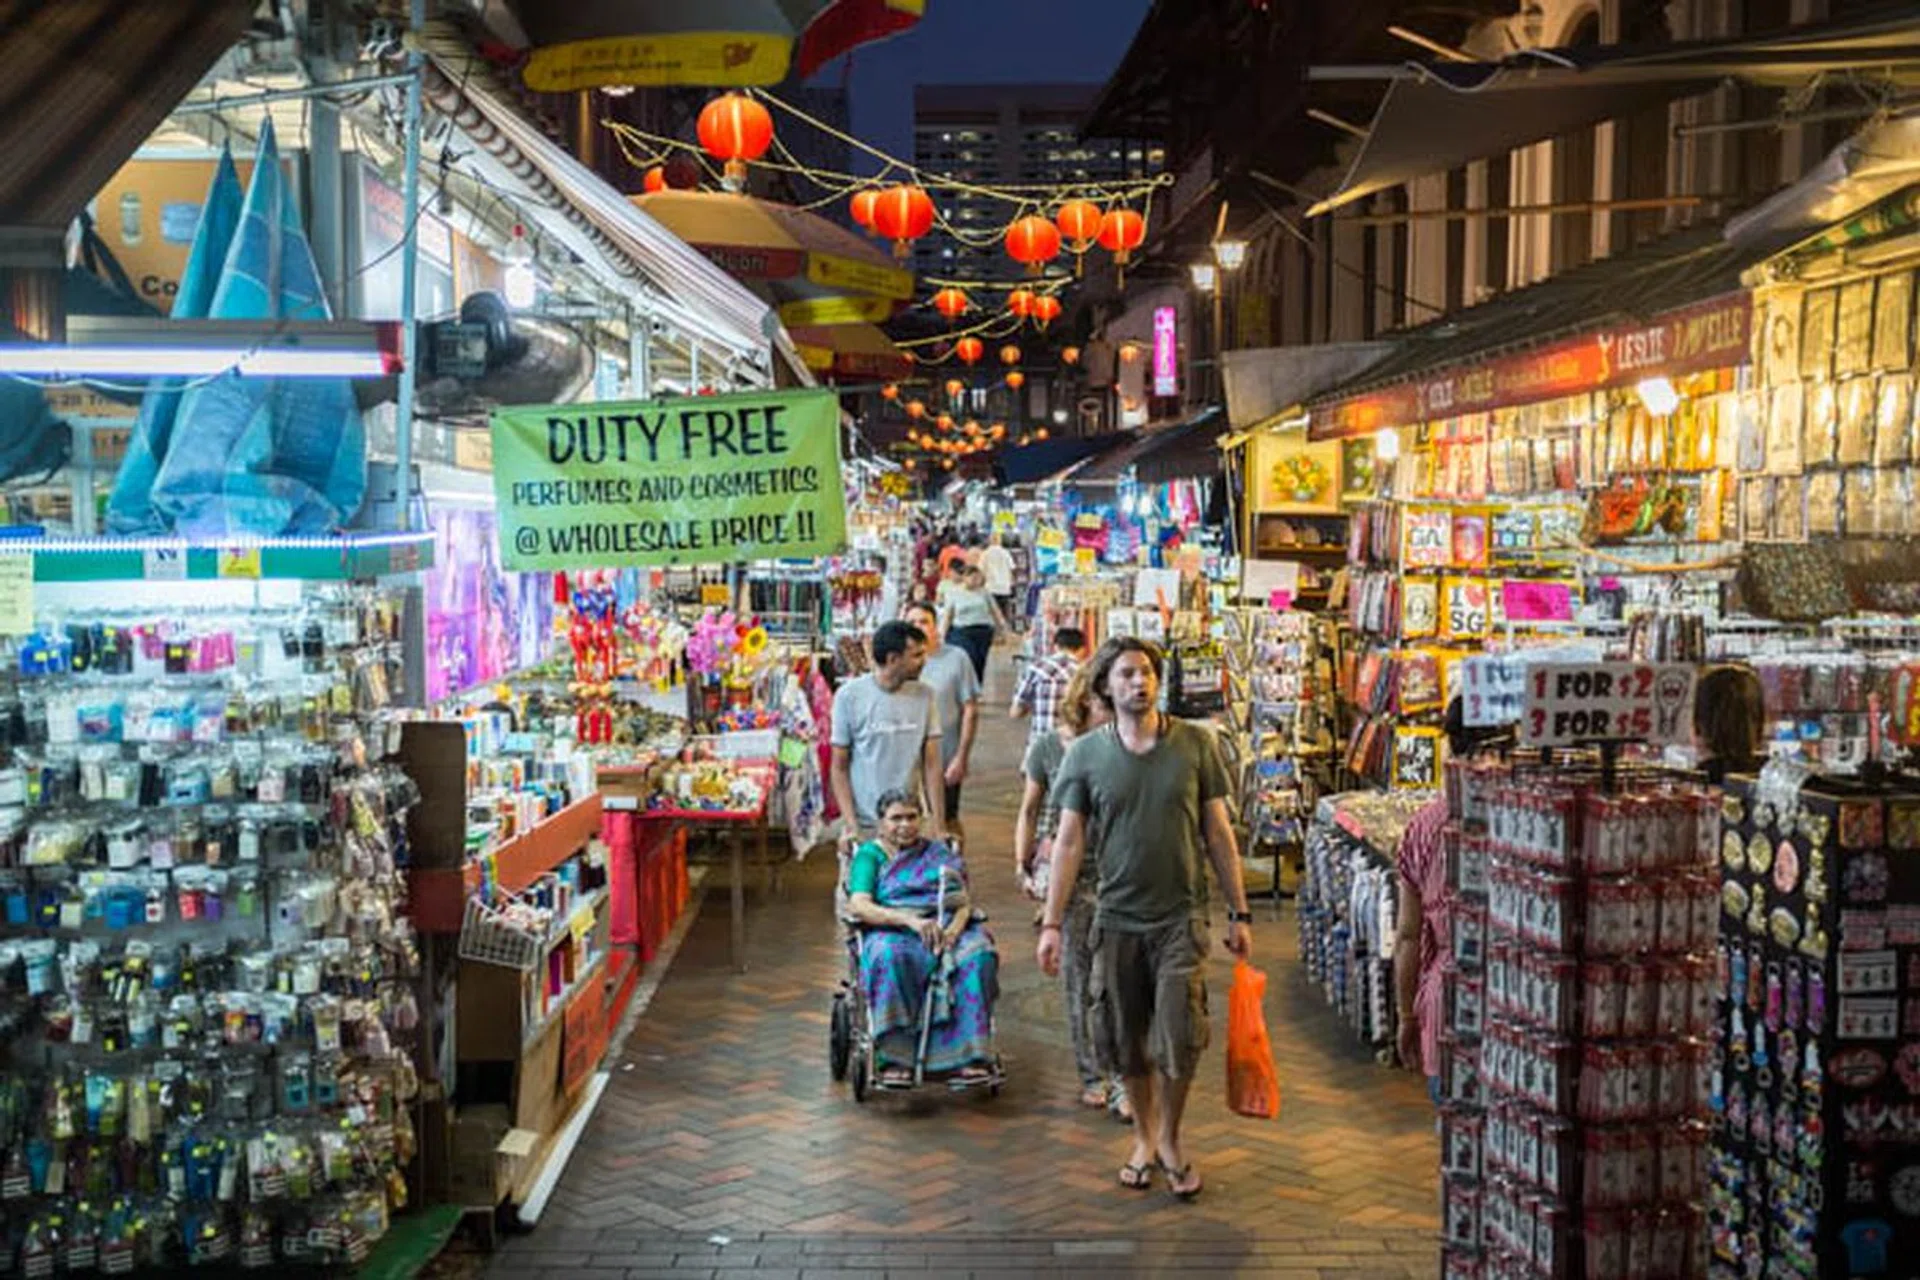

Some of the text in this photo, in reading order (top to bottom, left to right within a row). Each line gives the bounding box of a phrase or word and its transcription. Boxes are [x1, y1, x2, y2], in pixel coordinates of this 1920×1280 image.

[1618, 327, 1665, 370] LESLIE
[547, 406, 789, 465] DUTY FREE
[512, 466, 818, 507] PERFUMES AND COSMETICS
[515, 526, 540, 556] @
[549, 519, 702, 554] WHOLESALE
[712, 514, 788, 547] PRICE
[1451, 611, 1485, 634] SG
[1534, 668, 1654, 700] 1 FOR $2
[1530, 708, 1652, 738] 3 FOR $5
